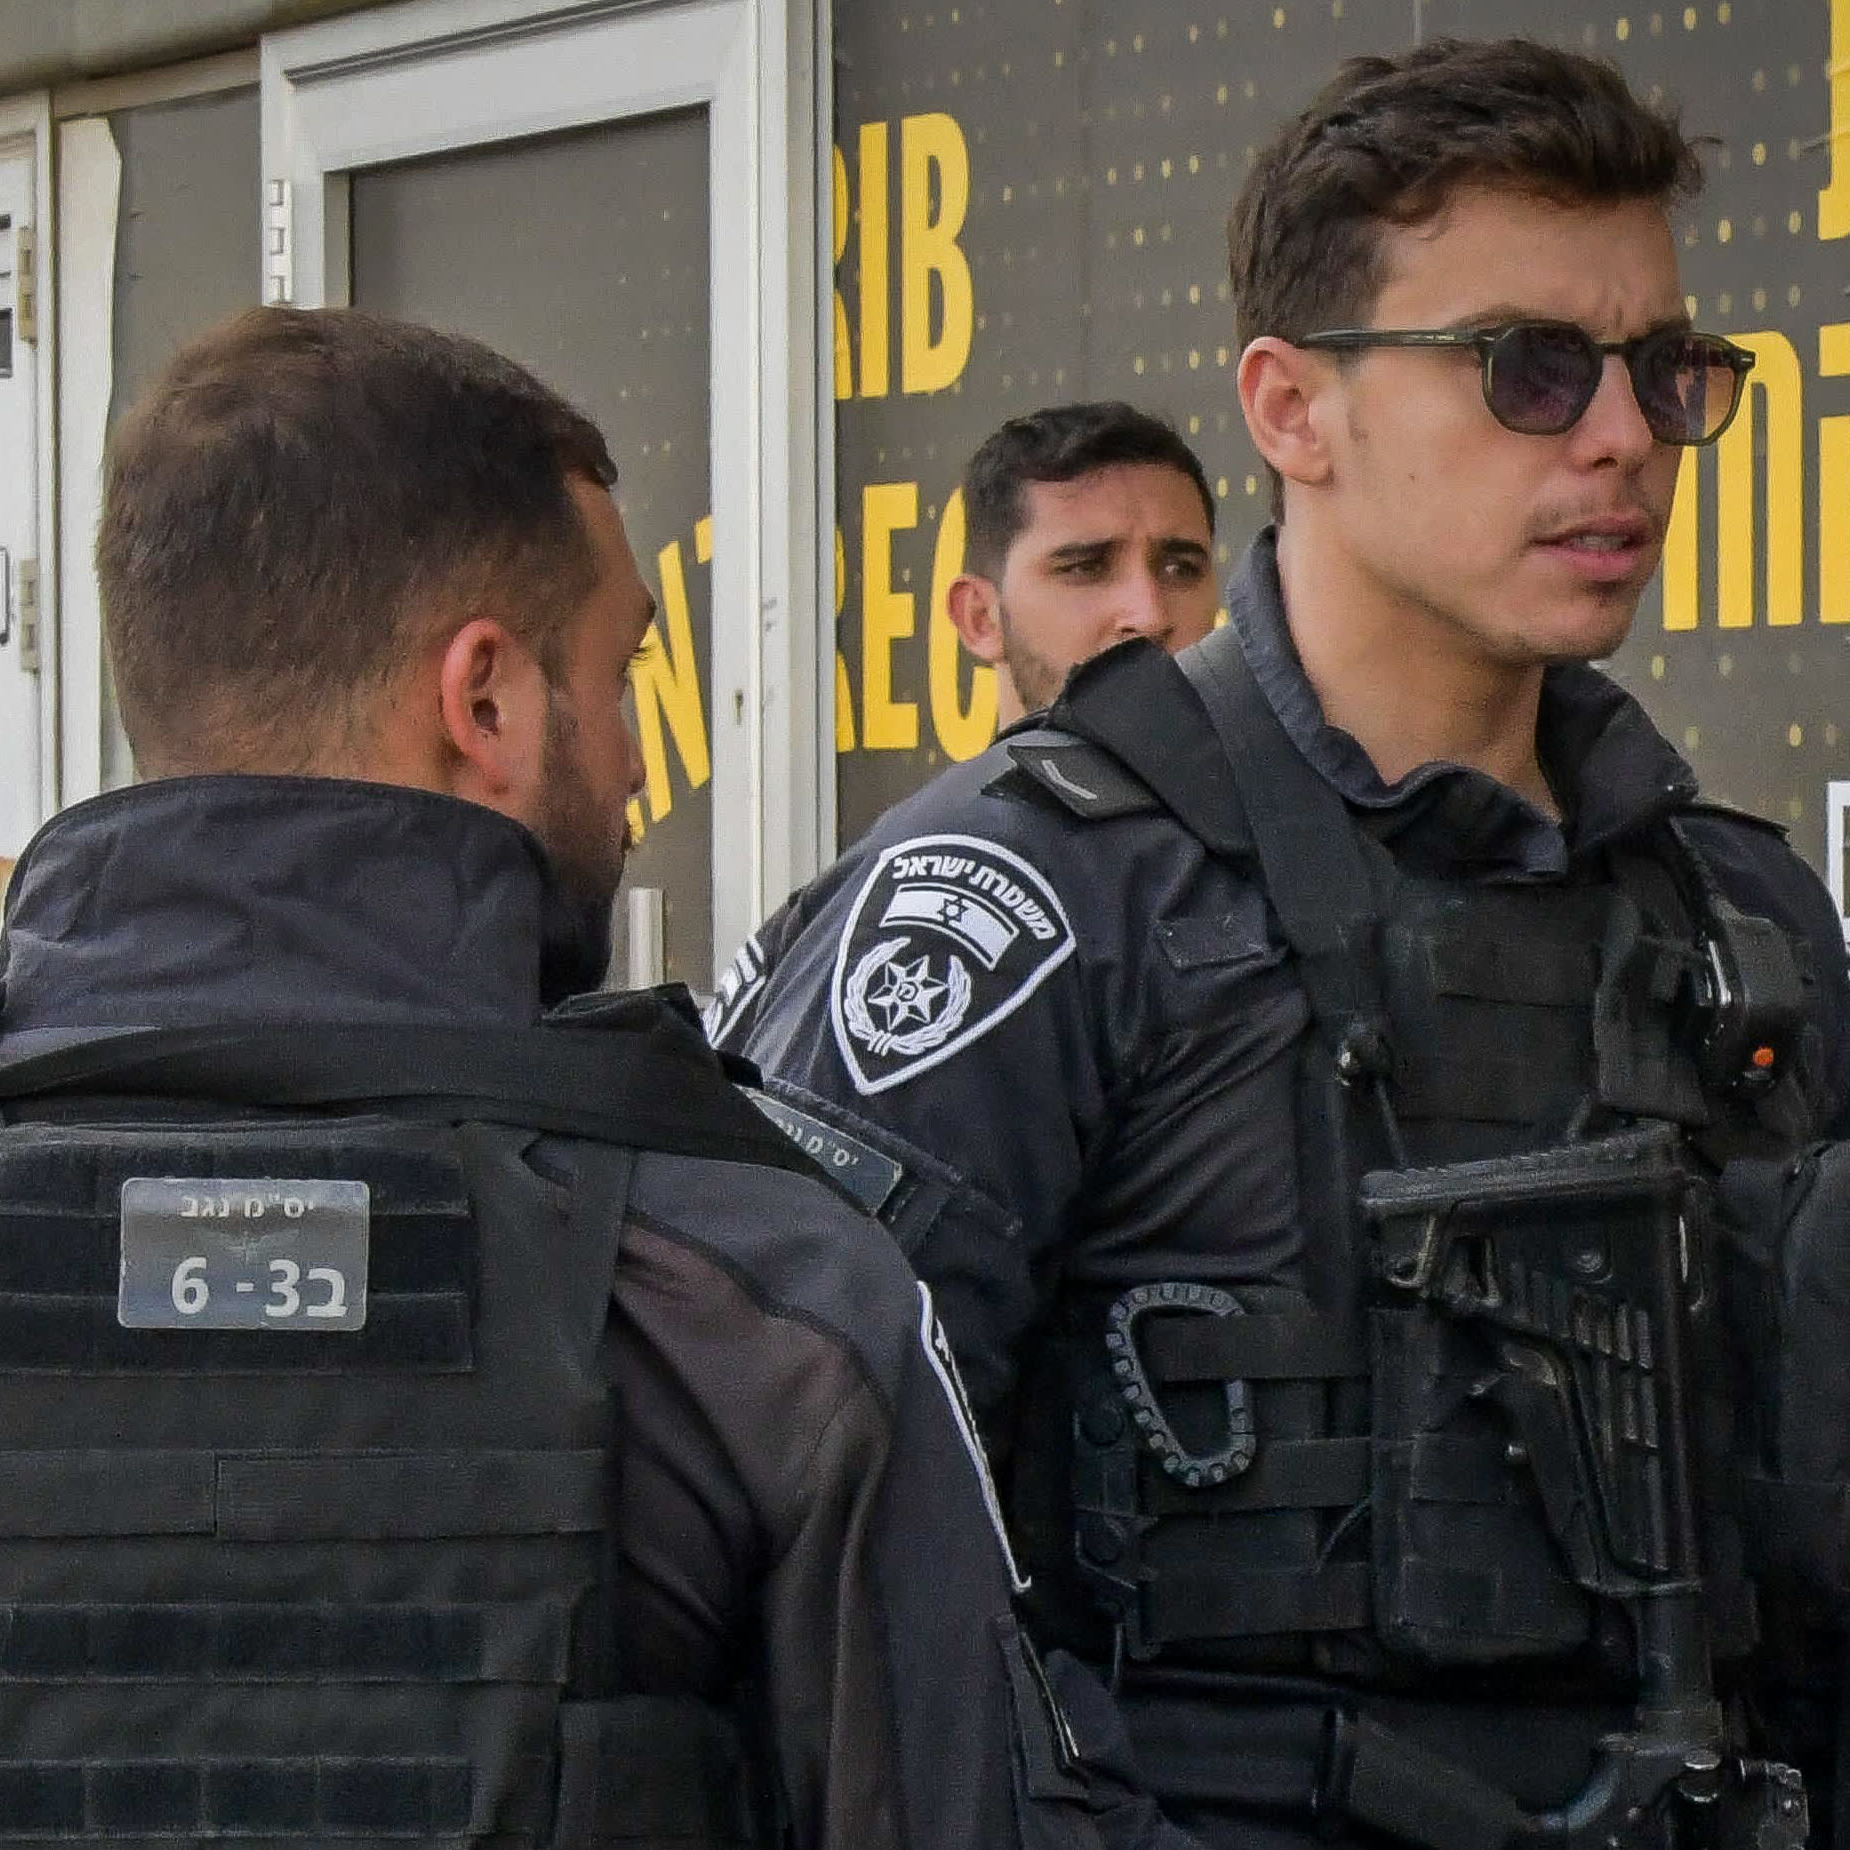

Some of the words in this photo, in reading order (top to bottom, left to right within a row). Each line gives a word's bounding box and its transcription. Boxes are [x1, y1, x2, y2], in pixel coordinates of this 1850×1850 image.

[833, 112, 974, 400] IB
[836, 481, 1000, 763] EC
[892, 855, 977, 880] ישראל
[969, 864, 1058, 940] משטרת
[180, 1195, 231, 1219] נגב
